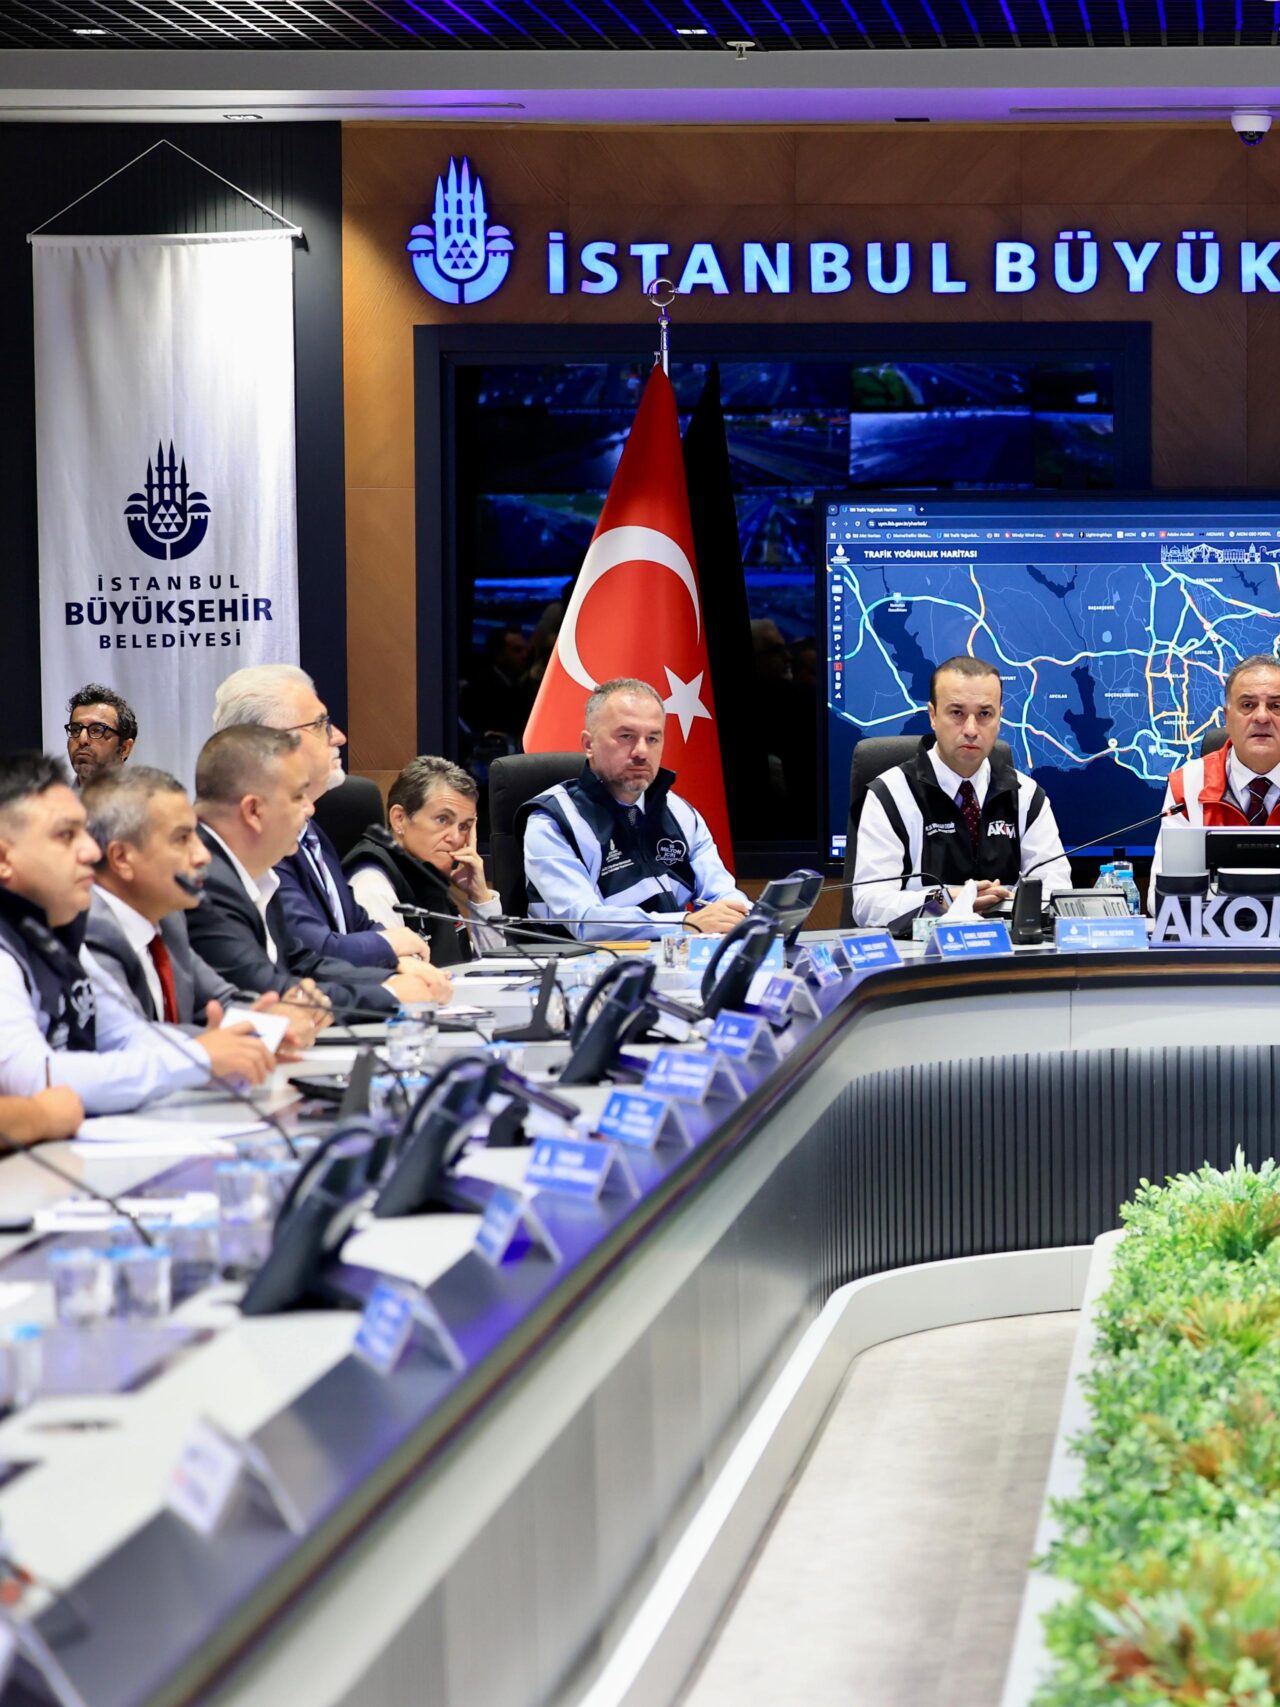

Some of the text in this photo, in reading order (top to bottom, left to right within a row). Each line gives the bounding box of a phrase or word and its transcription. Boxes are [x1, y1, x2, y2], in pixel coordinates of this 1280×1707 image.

[548, 231, 968, 294] İSTANBUL
[864, 549, 977, 558] TRAFİK YOĞUNLUK HARİTASI
[97, 574, 239, 591] İSTANBUL
[65, 593, 273, 626] BÜYÜKŞEHİR
[99, 629, 241, 649] BELEDİYESİ
[987, 822, 1016, 838] AKM
